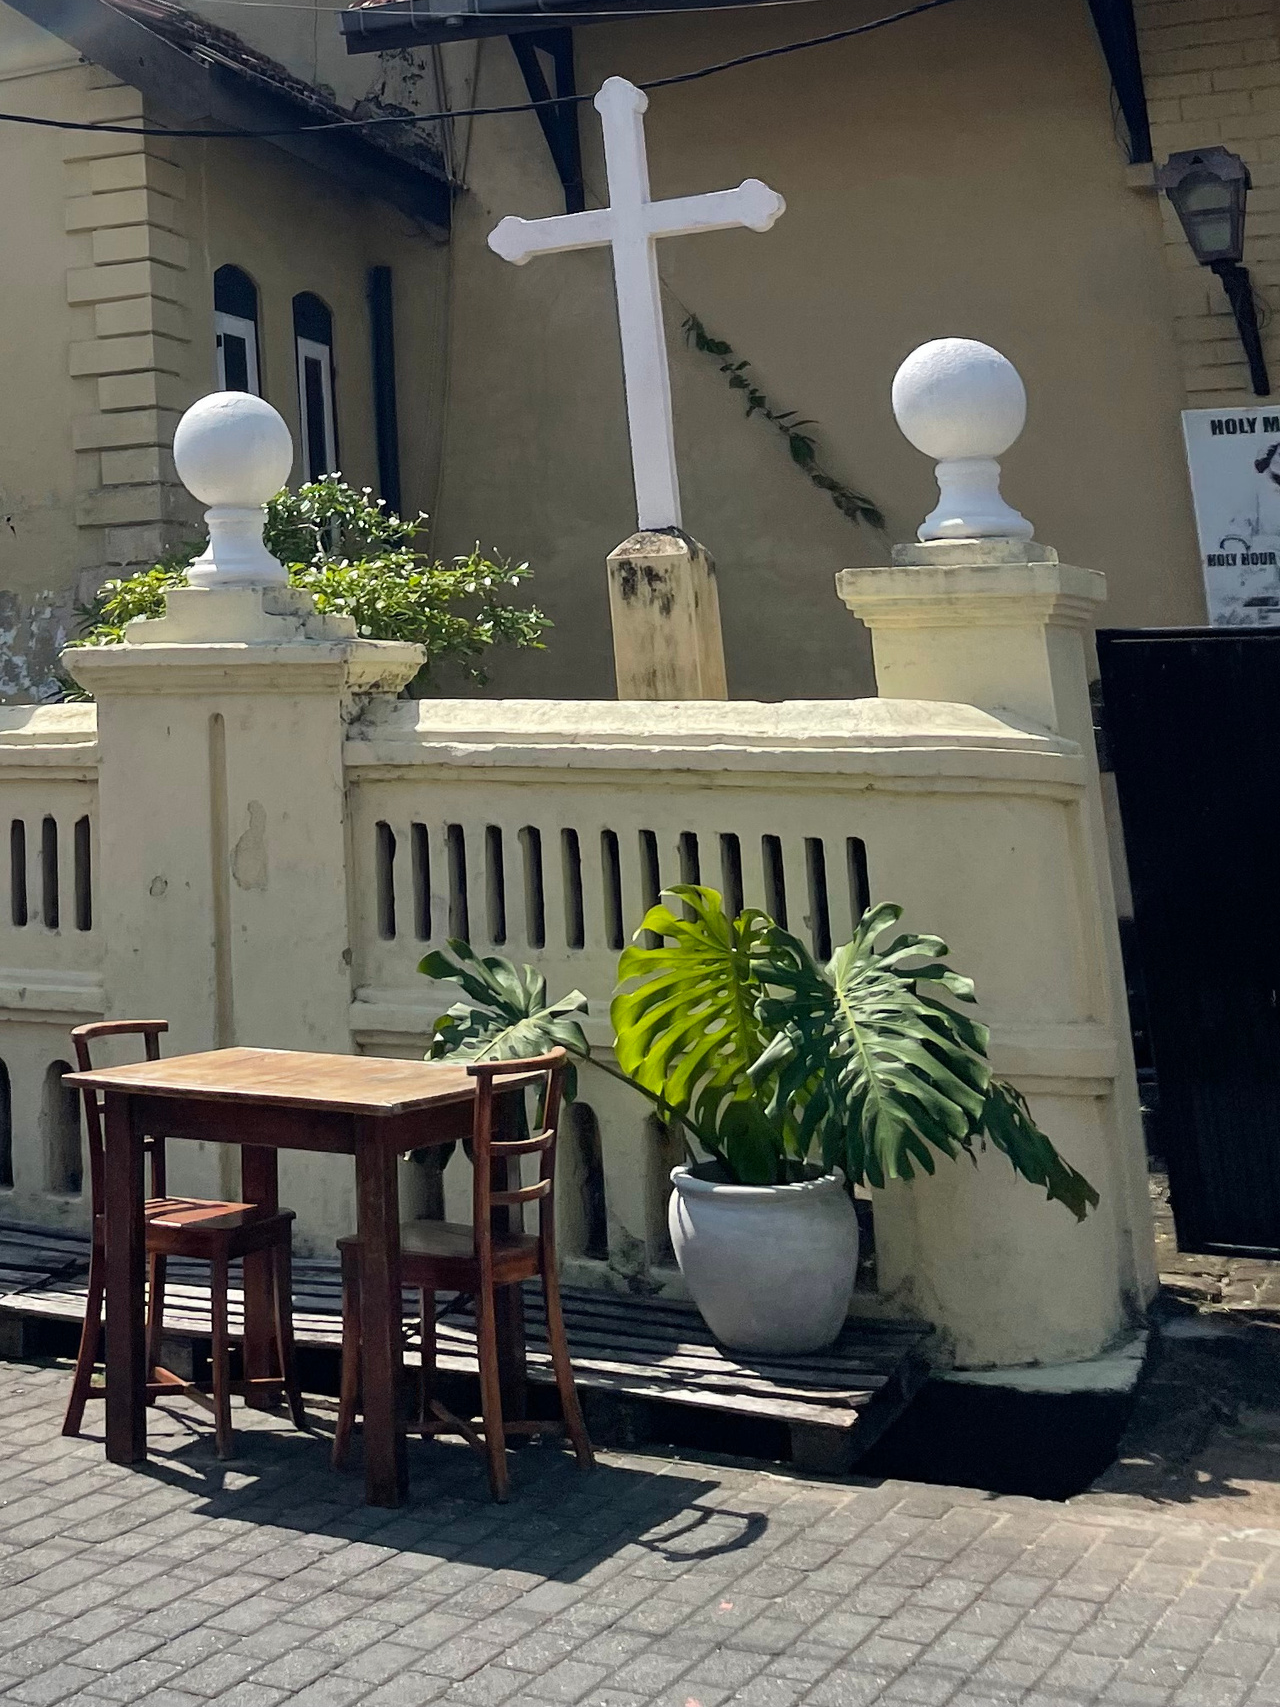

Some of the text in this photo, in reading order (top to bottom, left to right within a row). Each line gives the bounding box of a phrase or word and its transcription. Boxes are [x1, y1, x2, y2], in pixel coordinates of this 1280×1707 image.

[1210, 417, 1257, 435] HOLY
[1207, 552, 1277, 567] HOLY HOUR
